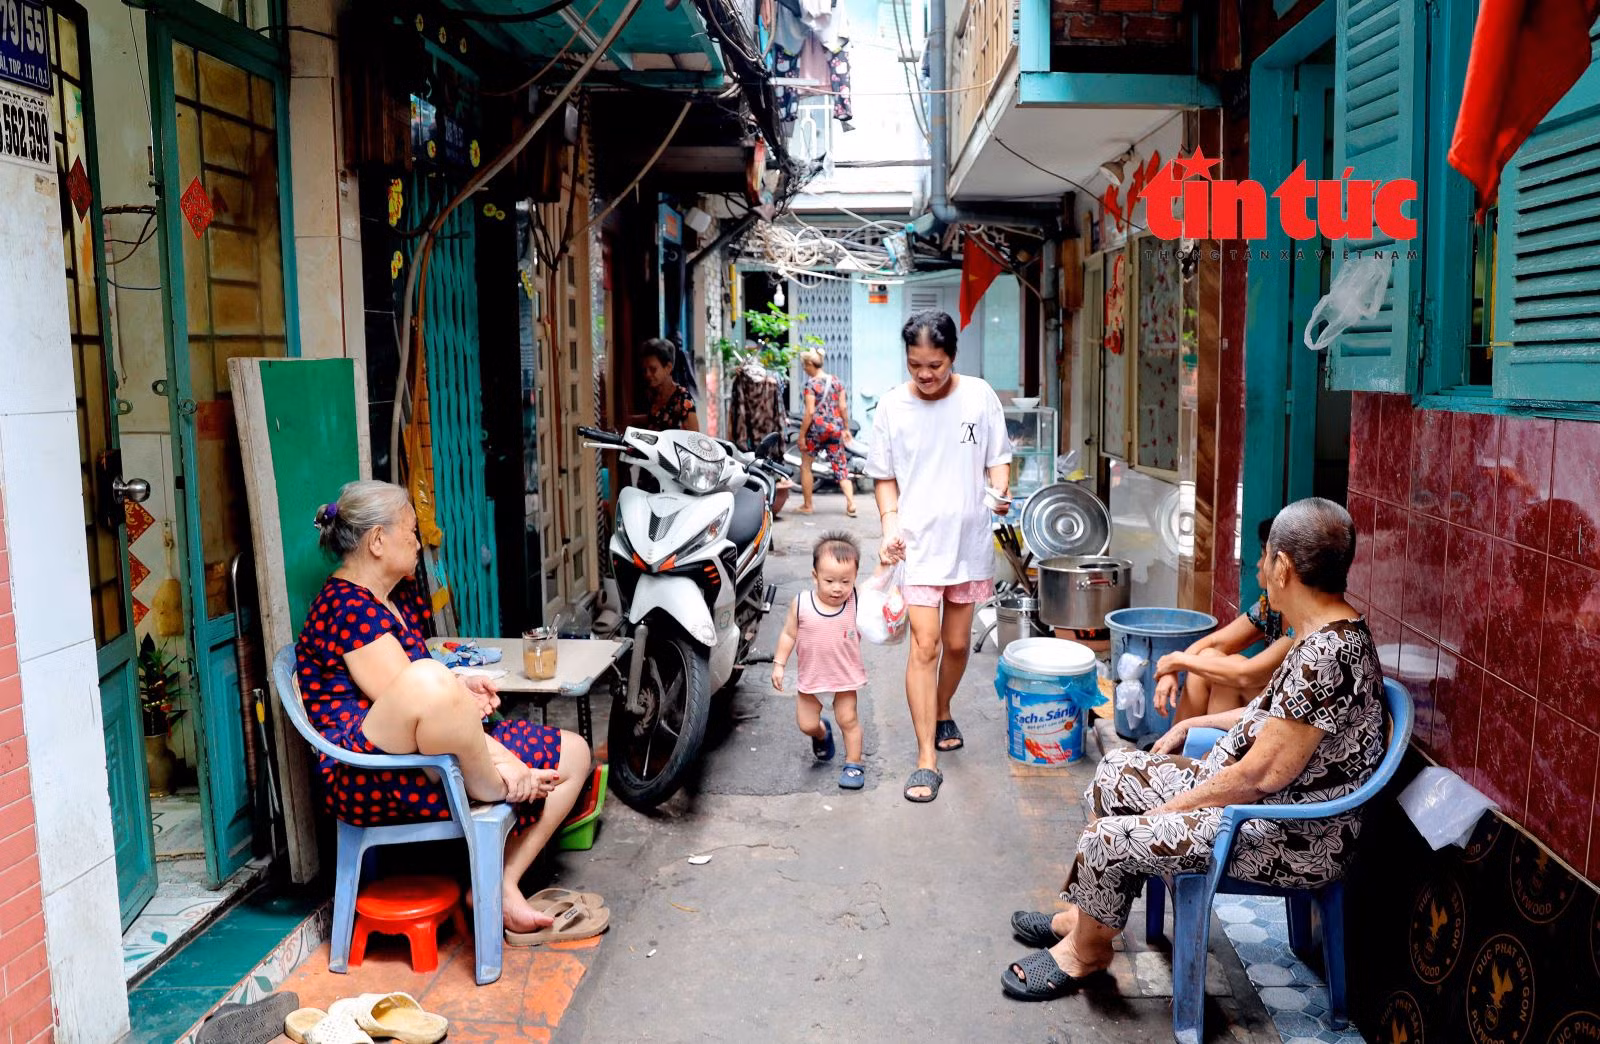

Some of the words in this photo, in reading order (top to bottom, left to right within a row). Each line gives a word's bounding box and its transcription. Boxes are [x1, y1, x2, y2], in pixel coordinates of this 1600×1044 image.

[1476, 948, 1493, 976] DUC
[1494, 943, 1519, 959] PHAT
[1515, 956, 1529, 982] SAI
[1518, 986, 1530, 1022] GON
